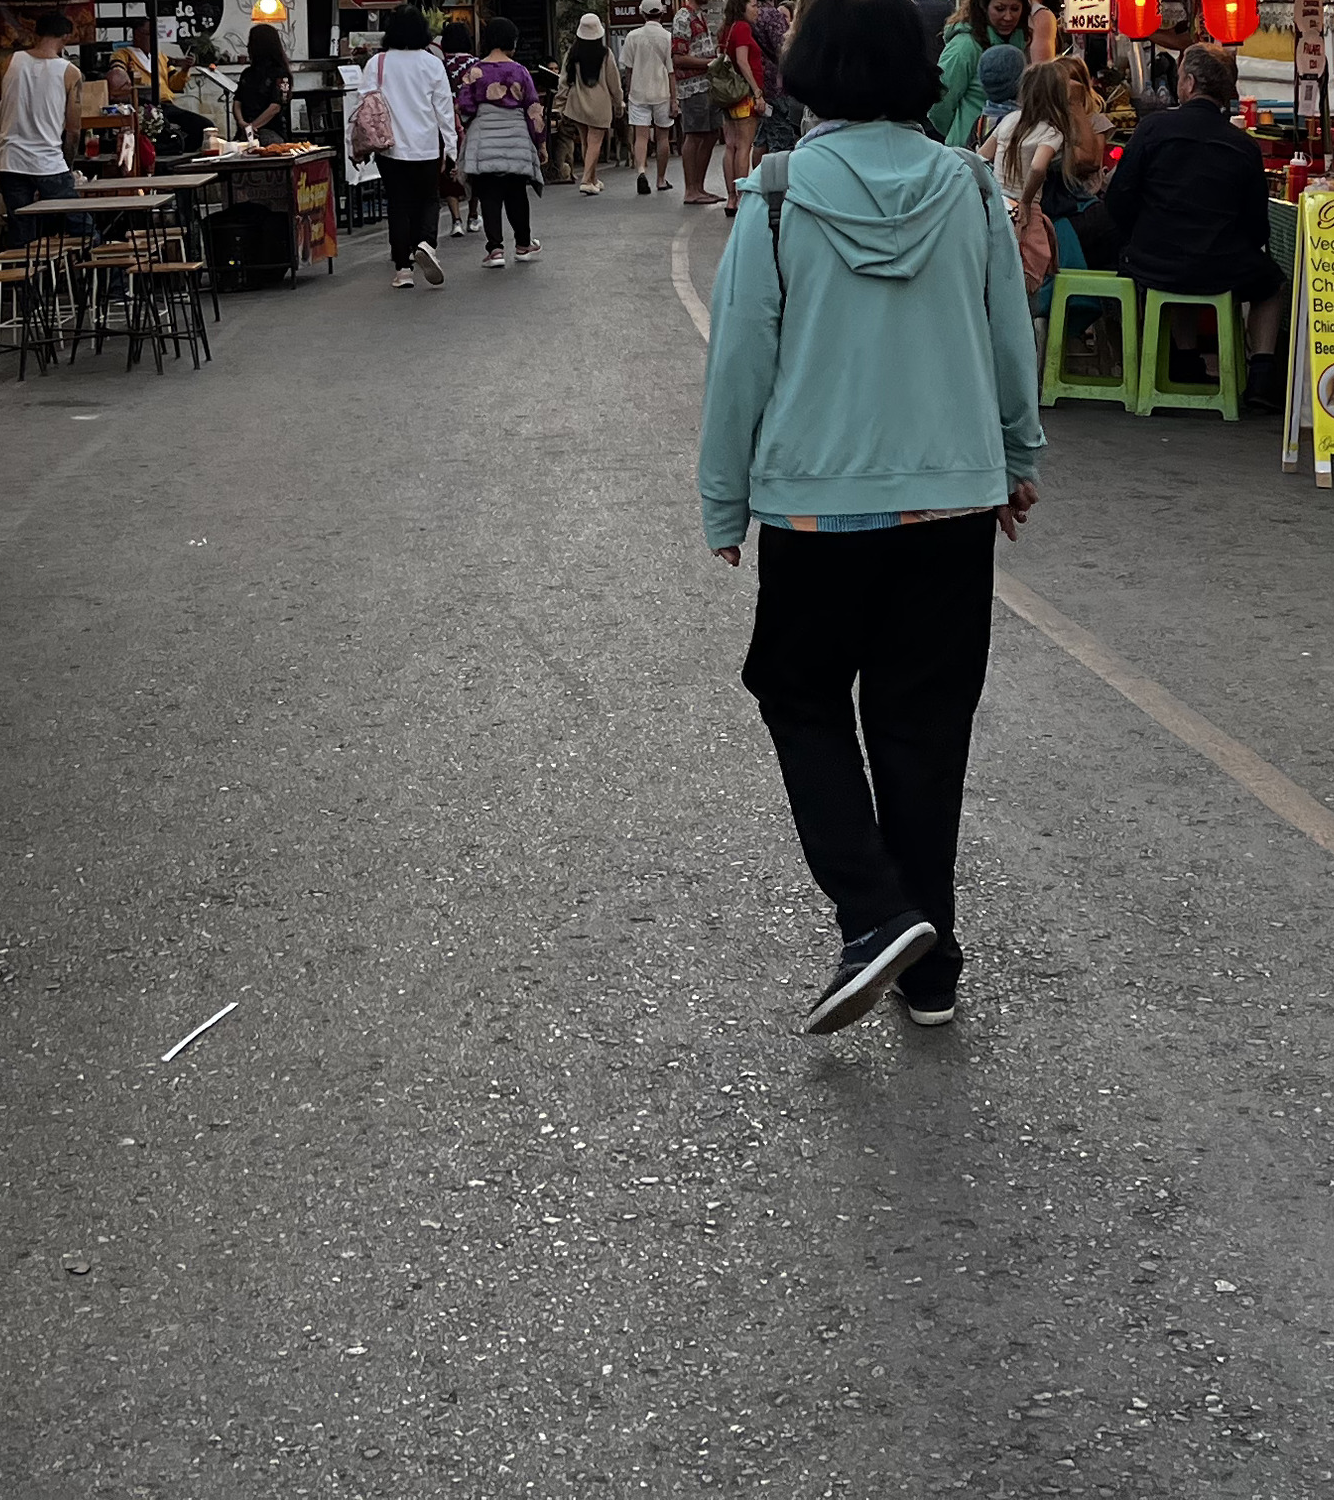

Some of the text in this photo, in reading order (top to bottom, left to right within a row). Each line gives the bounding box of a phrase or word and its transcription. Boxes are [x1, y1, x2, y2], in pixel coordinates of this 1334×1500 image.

[175, 0, 195, 18] de
[614, 6, 636, 16] BLUE
[178, 18, 202, 38] ai
